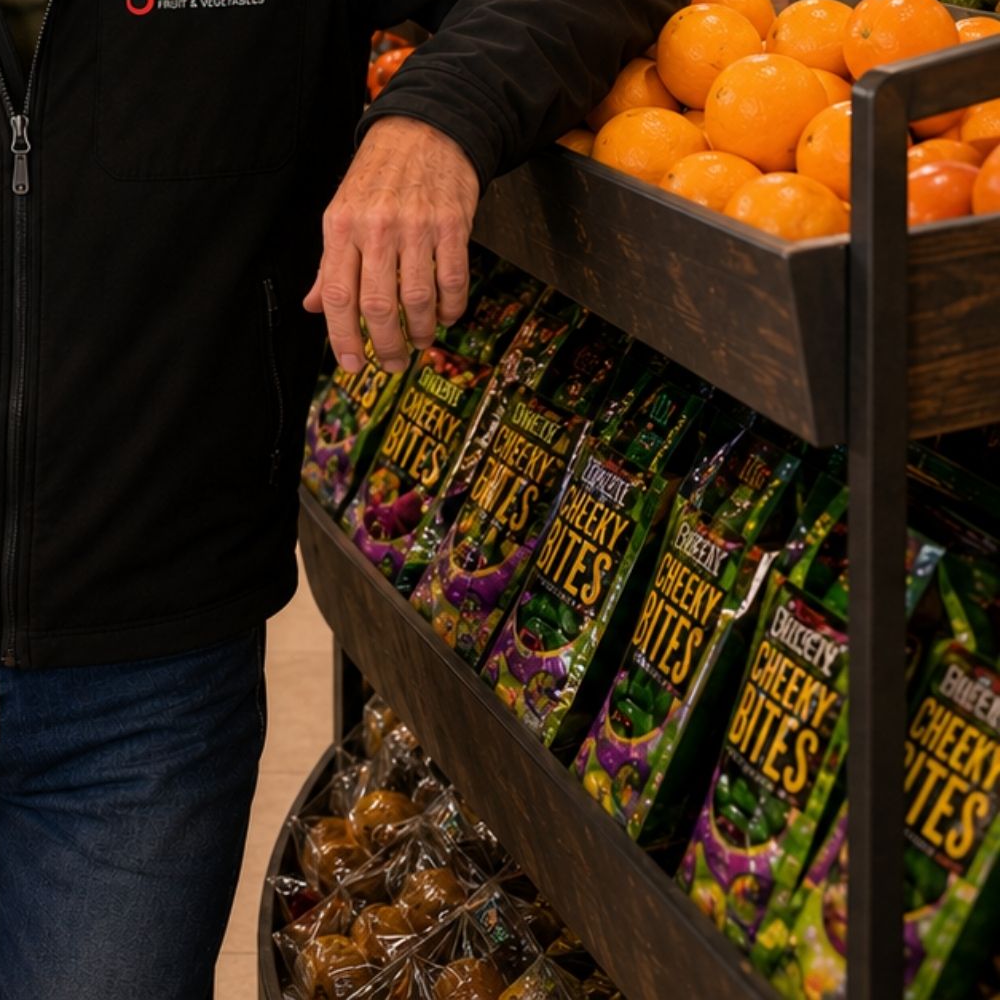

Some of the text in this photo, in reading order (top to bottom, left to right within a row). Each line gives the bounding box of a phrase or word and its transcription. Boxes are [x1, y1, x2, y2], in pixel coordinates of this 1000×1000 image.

[381, 413, 448, 488] BITES
[401, 386, 462, 444] CHEEKY
[491, 424, 557, 485] CHEEKY
[560, 484, 630, 551] CHEEKY
[536, 517, 613, 606] BITES
[655, 552, 724, 626] CHEEKY
[631, 589, 704, 685] BITES
[751, 640, 839, 729] CHEEKY
[728, 681, 820, 795] BITES
[903, 739, 990, 860] ITES
